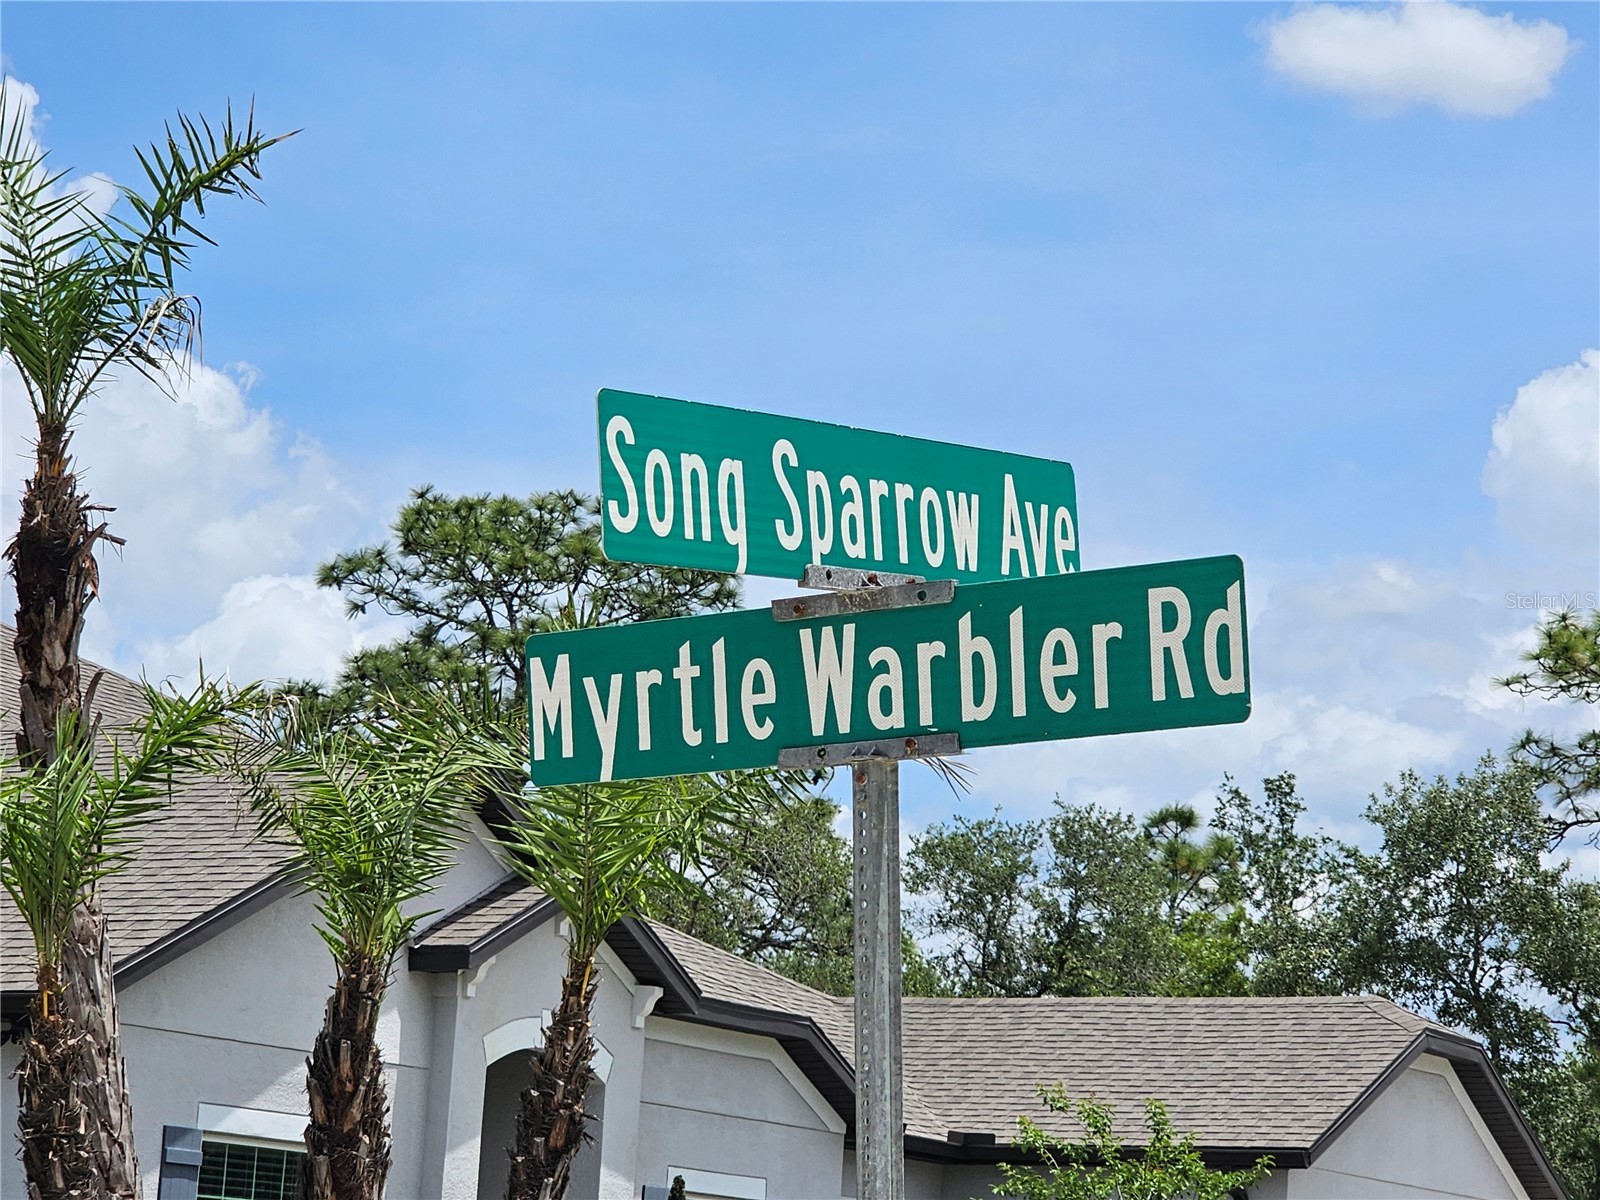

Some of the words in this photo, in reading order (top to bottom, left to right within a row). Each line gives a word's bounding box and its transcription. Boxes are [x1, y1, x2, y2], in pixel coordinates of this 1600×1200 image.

[605, 415, 748, 573] Song
[772, 439, 979, 573] Sparrow
[1000, 473, 1077, 576] Ave
[529, 637, 777, 782] Myrtle
[799, 605, 1124, 737] Warbler
[1147, 580, 1246, 702] Rd
